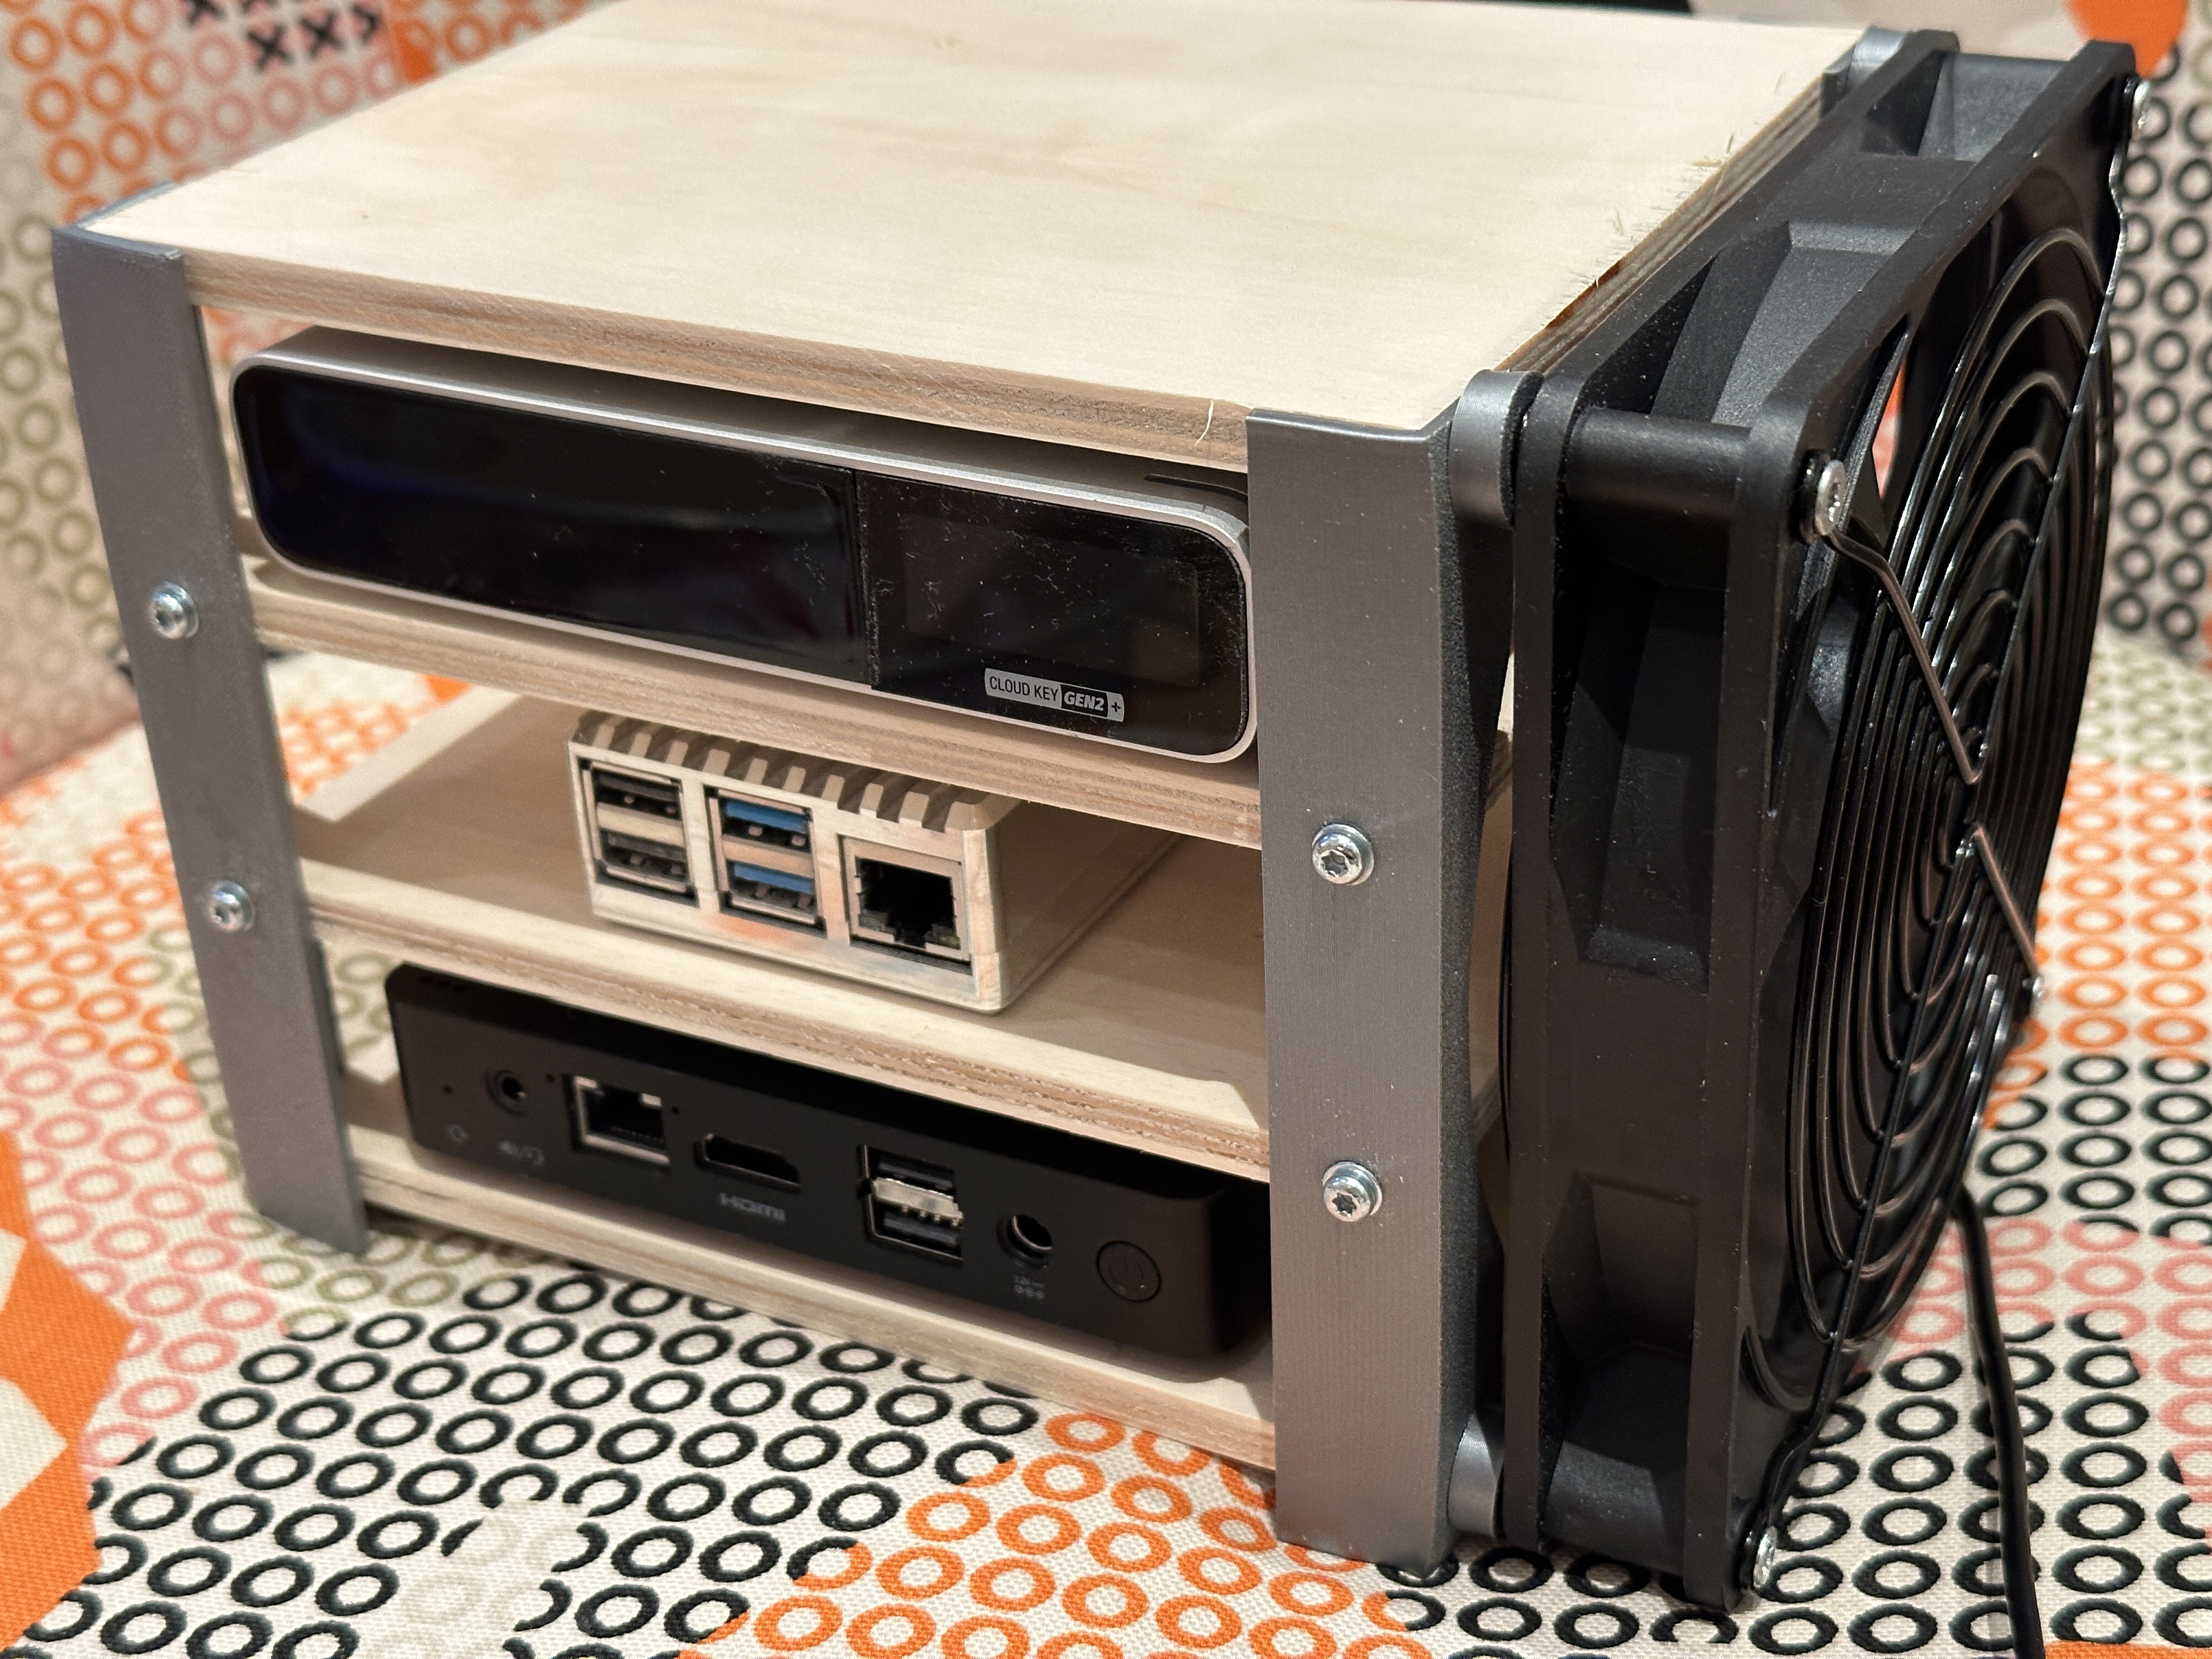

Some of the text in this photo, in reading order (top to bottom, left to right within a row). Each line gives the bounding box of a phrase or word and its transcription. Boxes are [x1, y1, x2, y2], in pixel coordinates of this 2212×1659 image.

[990, 676, 1030, 696] CLOUD
[1034, 685, 1059, 702] KEY
[1064, 691, 1104, 711] GEN2
